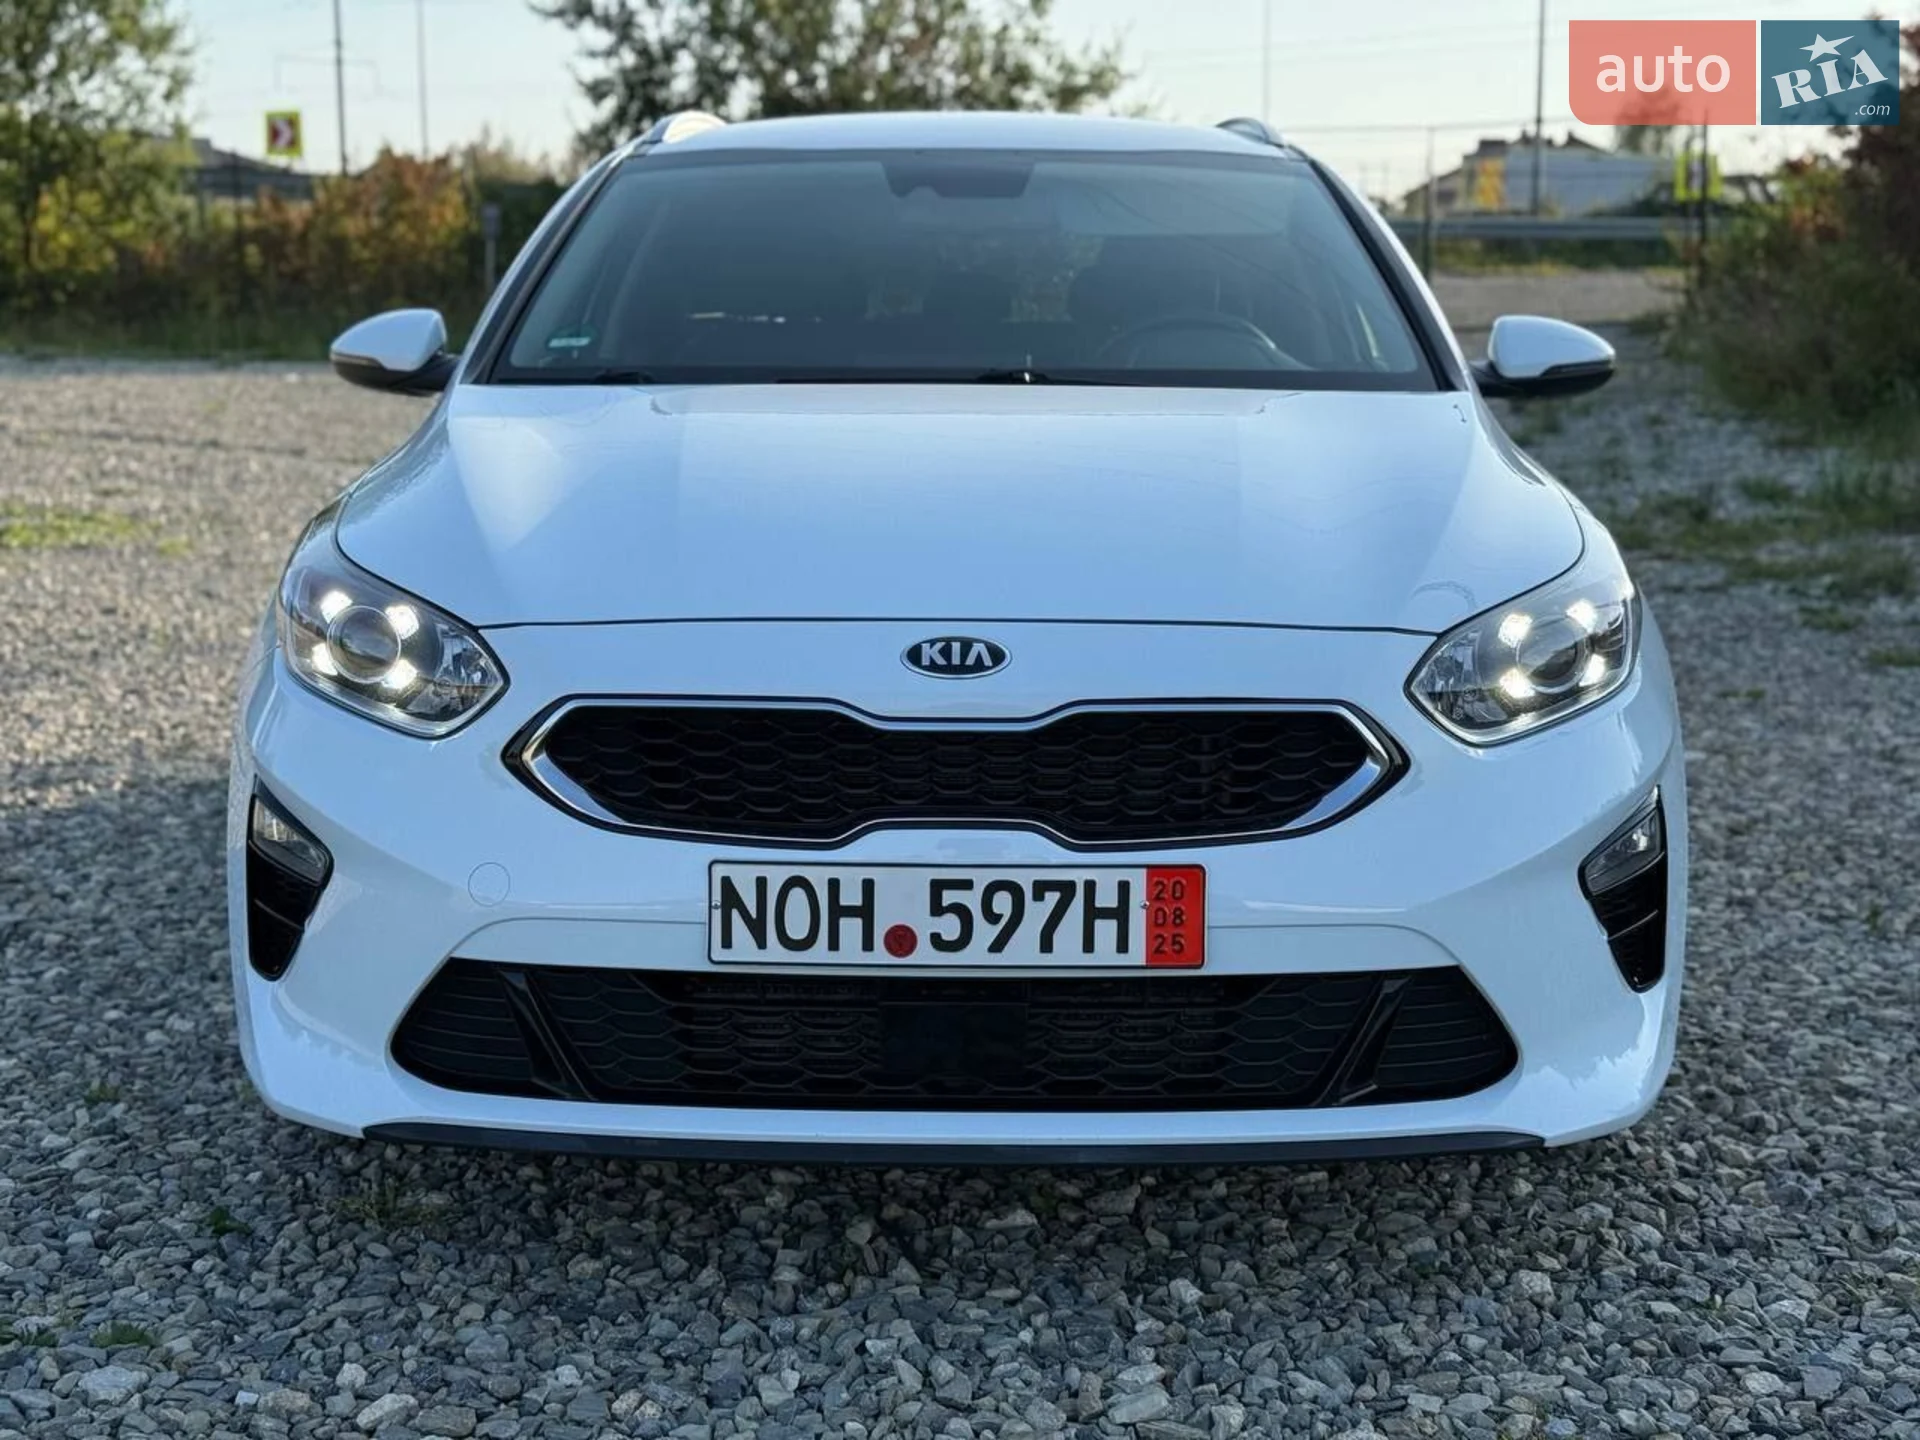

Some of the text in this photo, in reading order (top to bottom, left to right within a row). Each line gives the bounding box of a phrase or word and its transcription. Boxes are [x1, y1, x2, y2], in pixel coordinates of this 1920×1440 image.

[920, 641, 993, 667] KIA
[1153, 879, 1186, 901] 20
[720, 875, 1131, 954] NOH 597H
[1153, 905, 1186, 928] 08
[1153, 932, 1186, 955] 25
